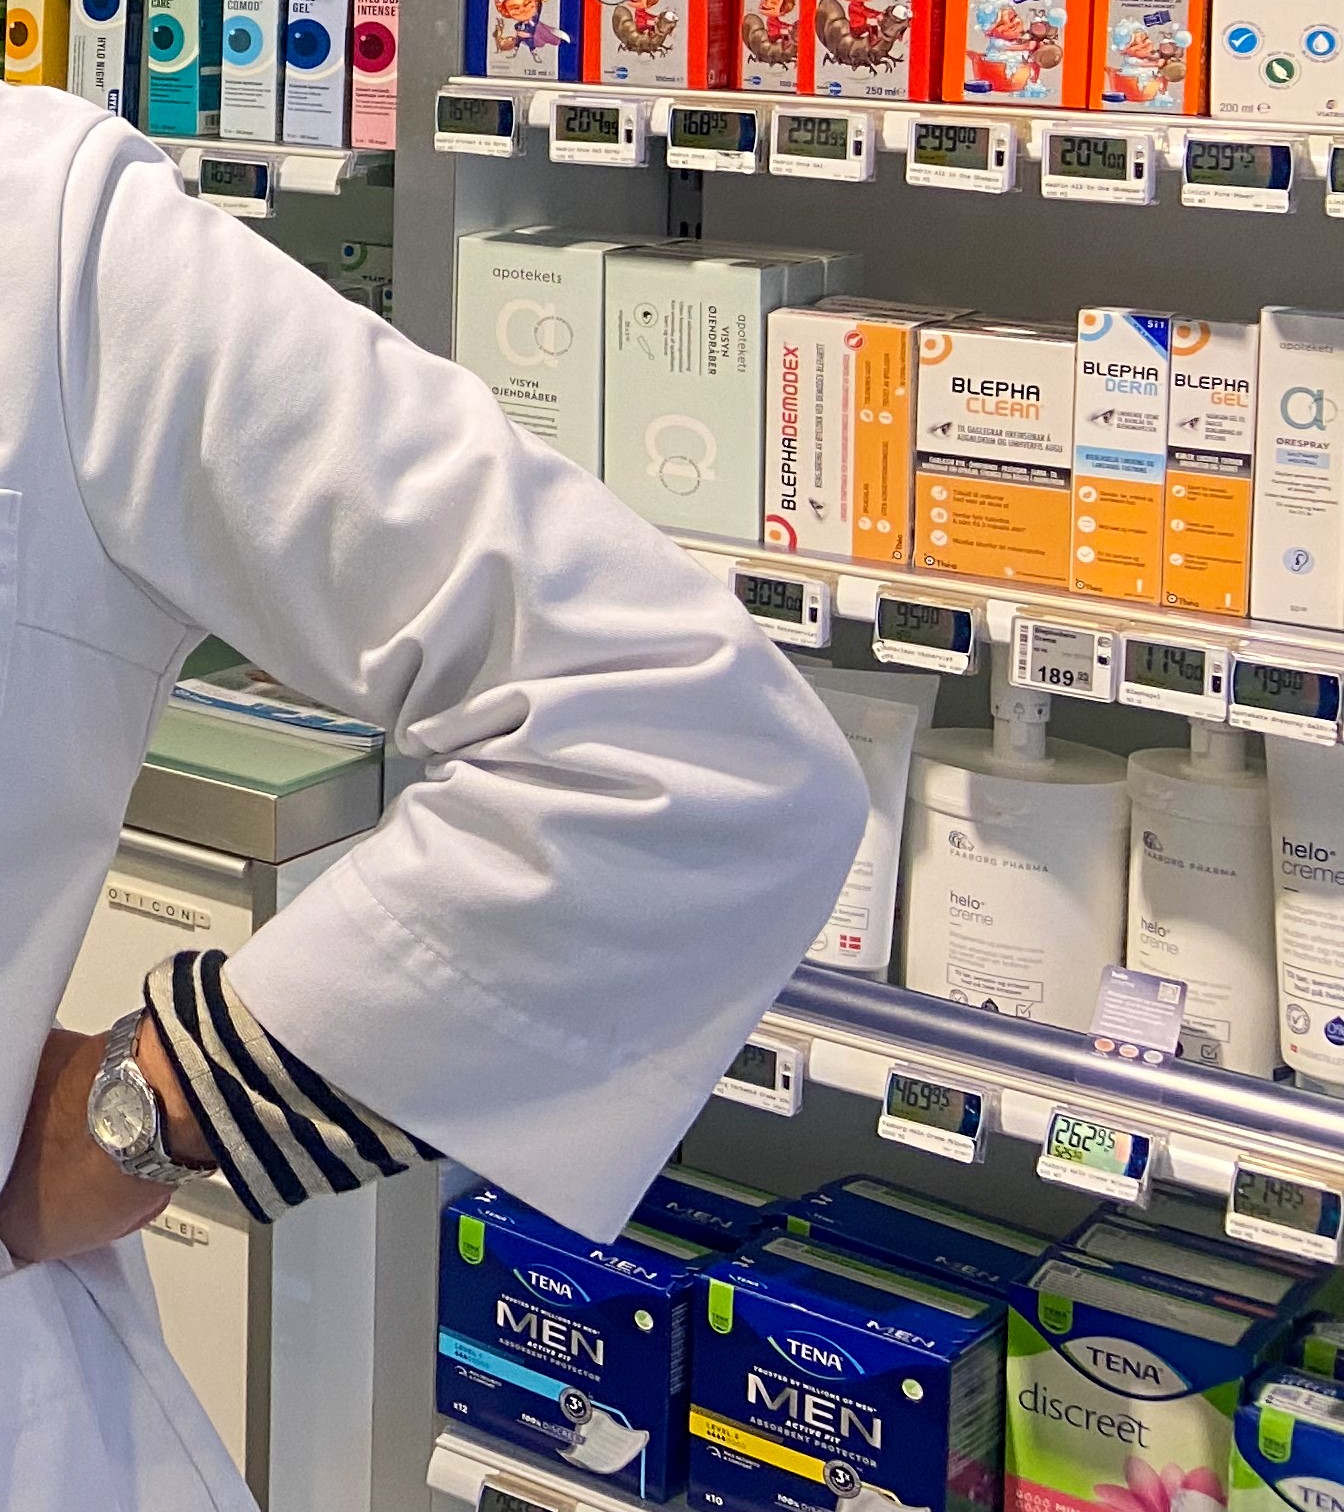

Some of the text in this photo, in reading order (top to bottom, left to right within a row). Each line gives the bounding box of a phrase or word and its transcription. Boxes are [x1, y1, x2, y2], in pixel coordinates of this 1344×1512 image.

[293, 3, 310, 13] GEL
[358, 5, 396, 16] INTENSE
[96, 37, 106, 88] HYLO NIGHT
[509, 377, 540, 389] VISYN
[1083, 361, 1159, 381] BLEPHA
[951, 377, 1041, 402] BLEPHA
[1104, 378, 1159, 397] DERM
[1174, 373, 1249, 394] BLEPHA
[966, 397, 1041, 420] CLEAN
[1211, 391, 1248, 408] GEL
[1037, 665, 1074, 687] 189
[109, 888, 190, 921] OTICON
[949, 906, 994, 926] creme
[590, 1250, 657, 1280] MEN
[528, 1270, 573, 1299] TENA
[496, 1299, 604, 1366] MEN
[786, 1338, 843, 1372] TENA
[1086, 1345, 1161, 1385] TENA
[747, 1372, 882, 1450] MEN
[1018, 1382, 1152, 1449] discreet
[749, 1416, 877, 1468] ABSORBENT PROTECTOR
[785, 1420, 841, 1444] ACTIVE FIT
